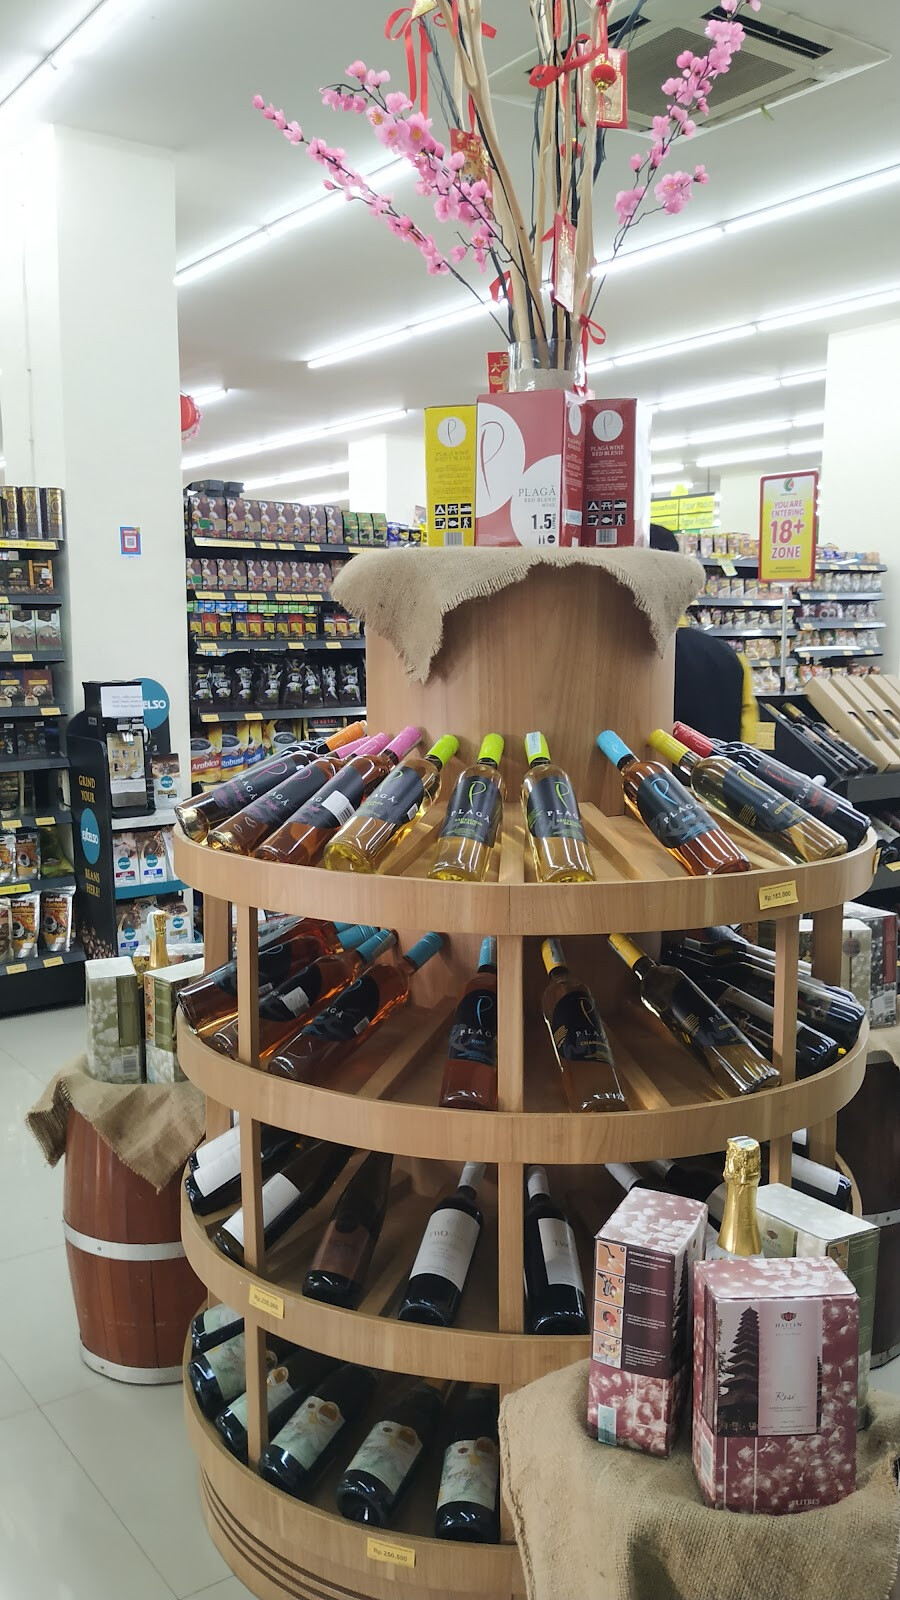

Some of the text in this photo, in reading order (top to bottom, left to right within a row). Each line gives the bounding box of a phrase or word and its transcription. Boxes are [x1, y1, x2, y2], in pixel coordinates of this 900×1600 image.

[774, 499, 803, 509] YOU ARE
[771, 508, 805, 518] ENTERING
[531, 513, 552, 529] 1.5
[770, 518, 805, 544] 18+
[771, 546, 801, 559] ZONE
[79, 775, 96, 789] GRIND
[81, 789, 96, 803] YOUR
[85, 867, 100, 883] BEANS
